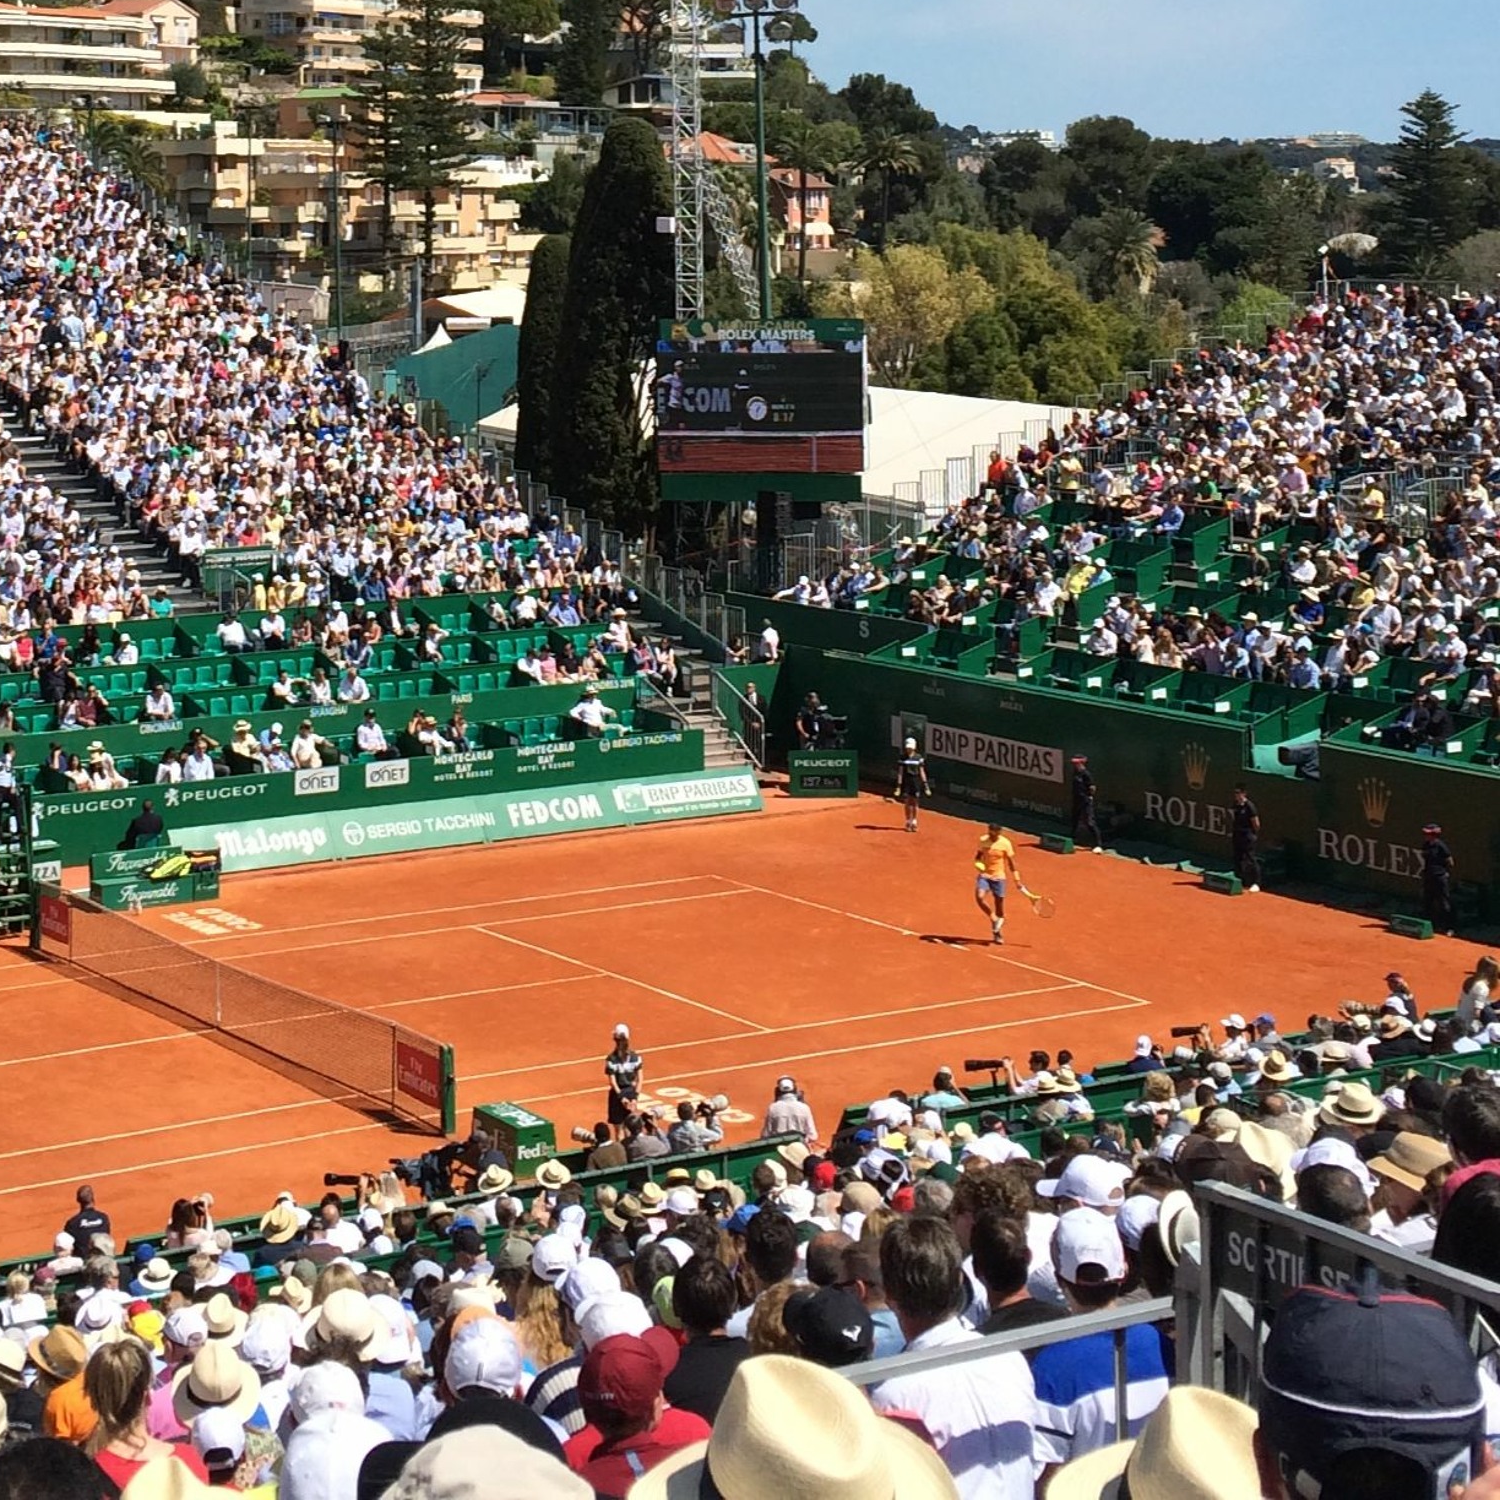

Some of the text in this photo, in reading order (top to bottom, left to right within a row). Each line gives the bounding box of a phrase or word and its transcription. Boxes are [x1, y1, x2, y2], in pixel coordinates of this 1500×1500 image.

[718, 329, 815, 340] ROLEX MASTERS
[794, 759, 852, 767] PEUGEOT
[931, 727, 1054, 777] BNP PARIBAS
[181, 782, 268, 802] PEUGEOT
[648, 778, 748, 803] BNP PARIBAS
[46, 797, 137, 816] PEUGEOT
[506, 793, 604, 828] FEDCOM
[1145, 792, 1236, 838] ROLE
[366, 811, 496, 839] SERGIO TACCHINI
[214, 825, 328, 857] Malongo
[398, 1064, 438, 1098] Emirates
[1228, 1231, 1304, 1288] SORTI
